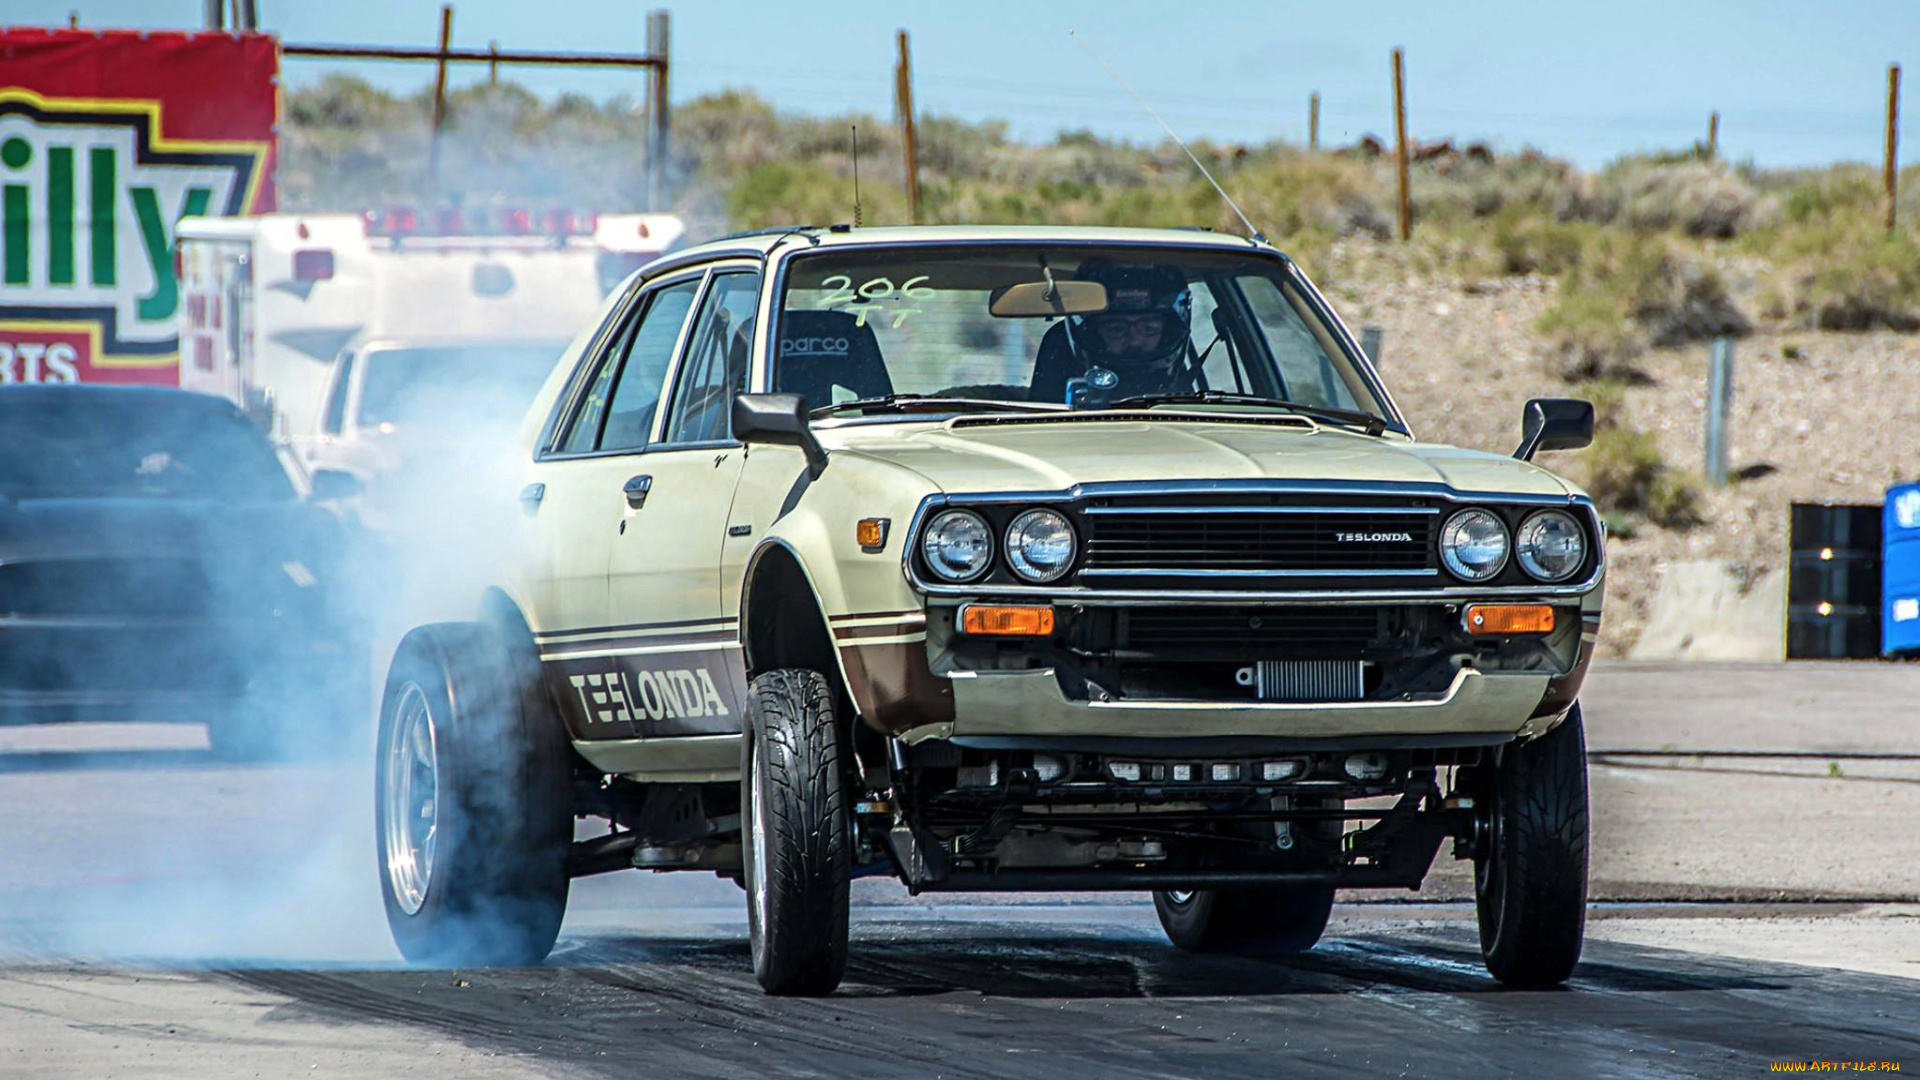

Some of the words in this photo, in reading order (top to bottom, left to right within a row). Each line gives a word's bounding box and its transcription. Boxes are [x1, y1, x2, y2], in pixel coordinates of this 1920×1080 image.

[816, 275, 936, 307] 206
[1336, 532, 1413, 542] TESLONDA
[569, 668, 729, 724] TESLONDA
